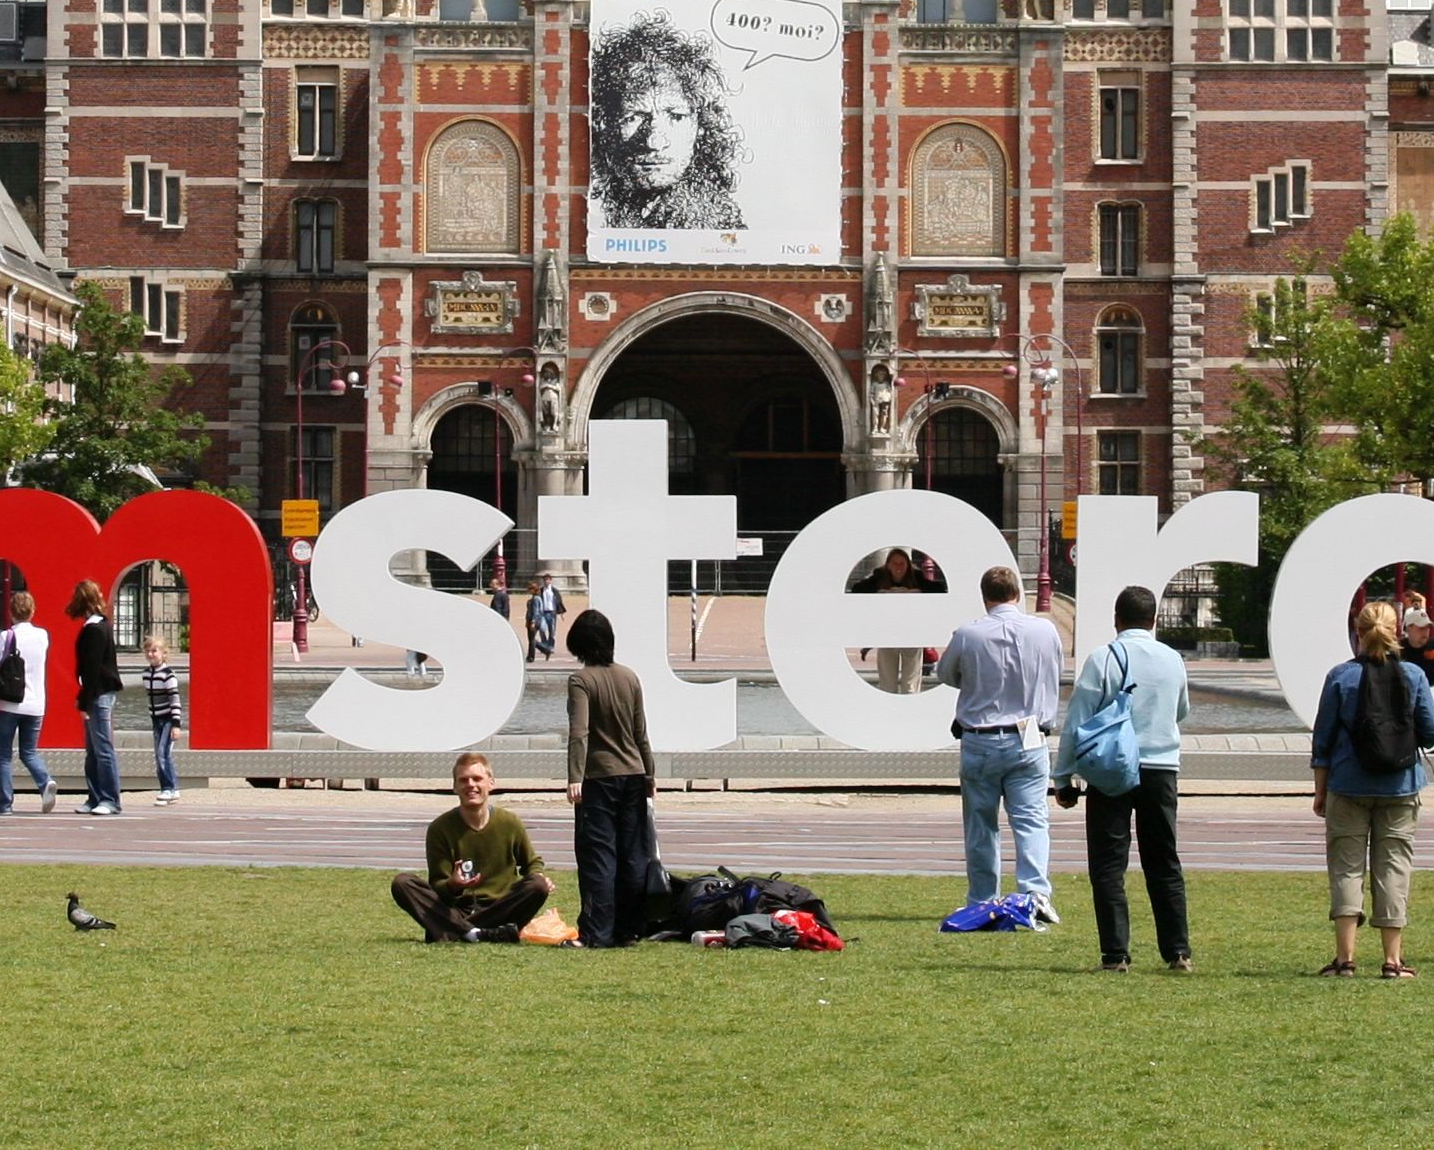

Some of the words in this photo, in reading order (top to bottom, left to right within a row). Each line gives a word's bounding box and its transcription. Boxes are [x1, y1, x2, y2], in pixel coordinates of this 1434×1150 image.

[725, 12, 773, 33] 400?
[778, 23, 825, 41] moi?
[605, 238, 667, 253] PHILIPS
[781, 244, 806, 254] ING
